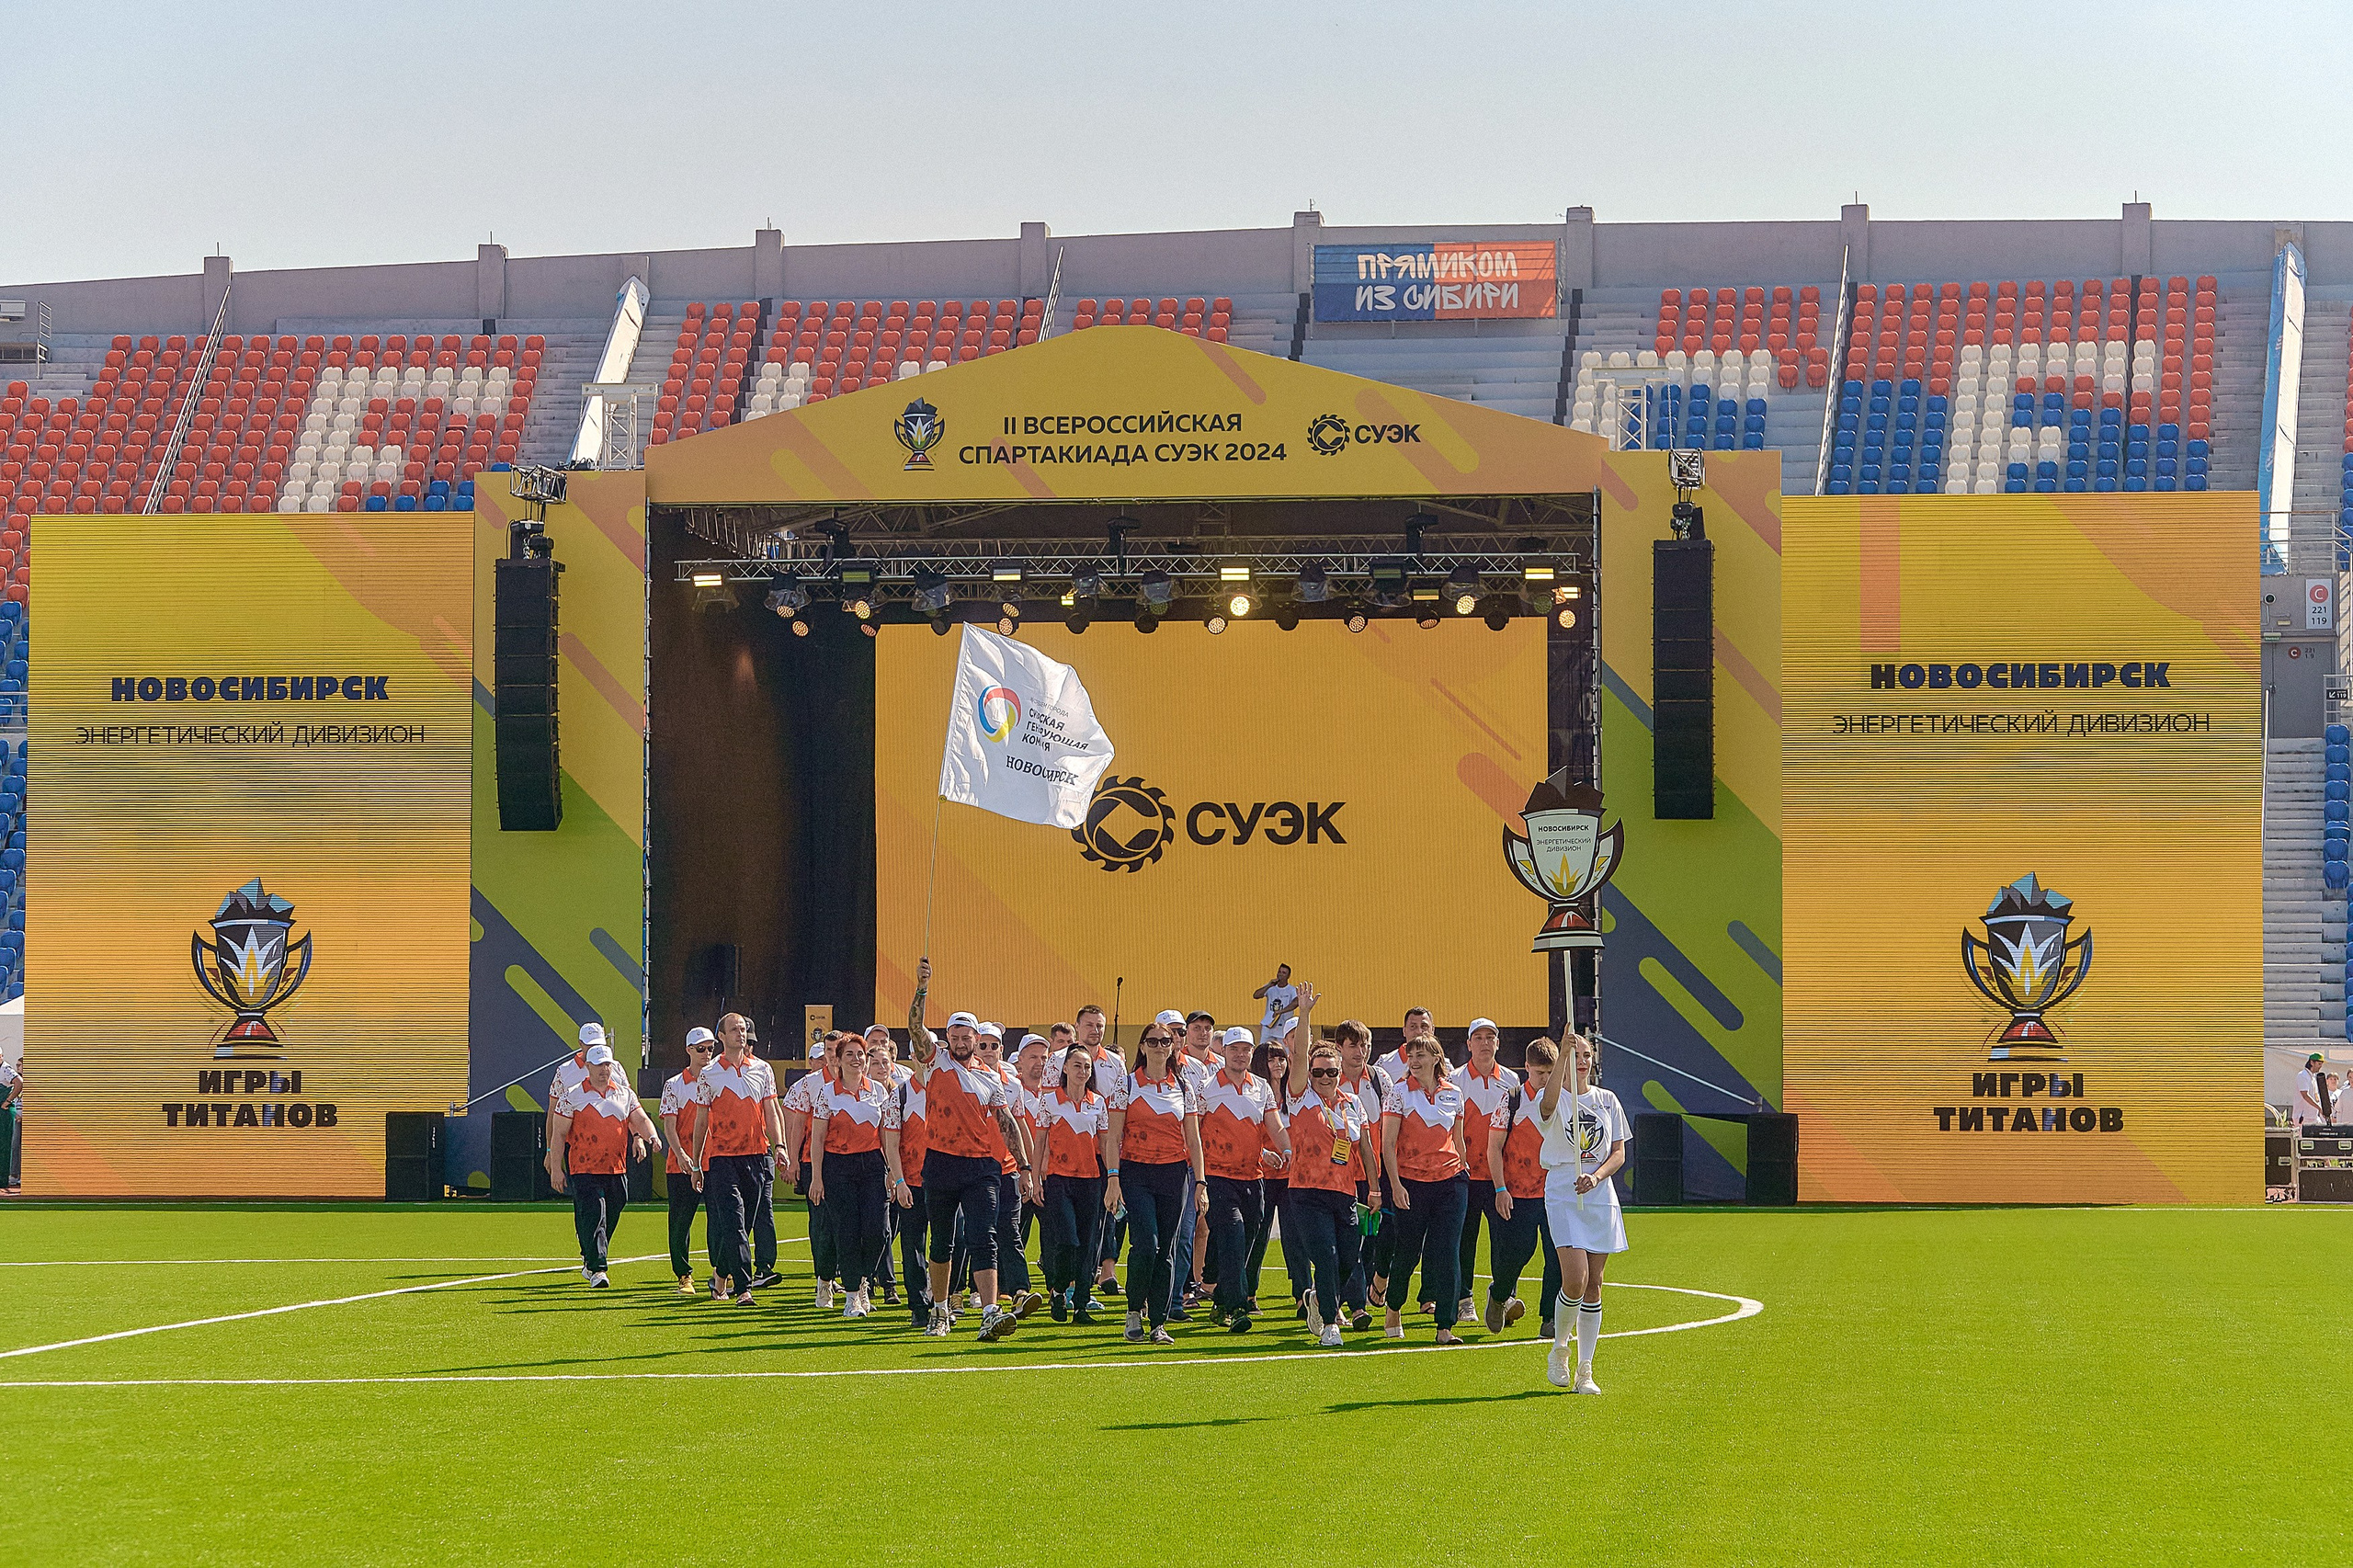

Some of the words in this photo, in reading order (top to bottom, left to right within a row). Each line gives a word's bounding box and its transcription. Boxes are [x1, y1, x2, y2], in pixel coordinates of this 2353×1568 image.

[1357, 251, 1518, 279] ПРЯМИКОМ
[1356, 285, 1396, 311] ИЗ
[1403, 281, 1518, 310] СИБИРИ
[1023, 410, 1243, 435] ВСЕРОССИЙСКАЯ
[1355, 424, 1421, 444] СУЭК
[959, 445, 1150, 466] СПАРТАКИАДА
[1154, 443, 1222, 463] СУЭК
[1224, 442, 1287, 461] 2024
[2312, 617, 2327, 625] 119
[1870, 662, 2171, 688] НОВОСИБИРСК
[111, 676, 389, 701] НОВОСИБИРСК
[74, 722, 284, 744] ЭНЕРГЕТИЧЕСКИЙ
[292, 725, 425, 746] ДИВИЗИОН
[1831, 710, 2058, 733] ЭНЕРГЕТИЧЕСКИЙ
[2067, 712, 2211, 736] ДИВИЗИОН
[1187, 801, 1347, 846] СУЭК
[1536, 837, 1591, 846] ЭНЕРГЕТИЧЕСКИЙ
[199, 1070, 301, 1094] ИГРЫ
[1972, 1073, 2084, 1097] ИГРЫ
[163, 1104, 338, 1127] ТИТАНОВ
[1934, 1107, 2123, 1131] ТИТАНОВ
